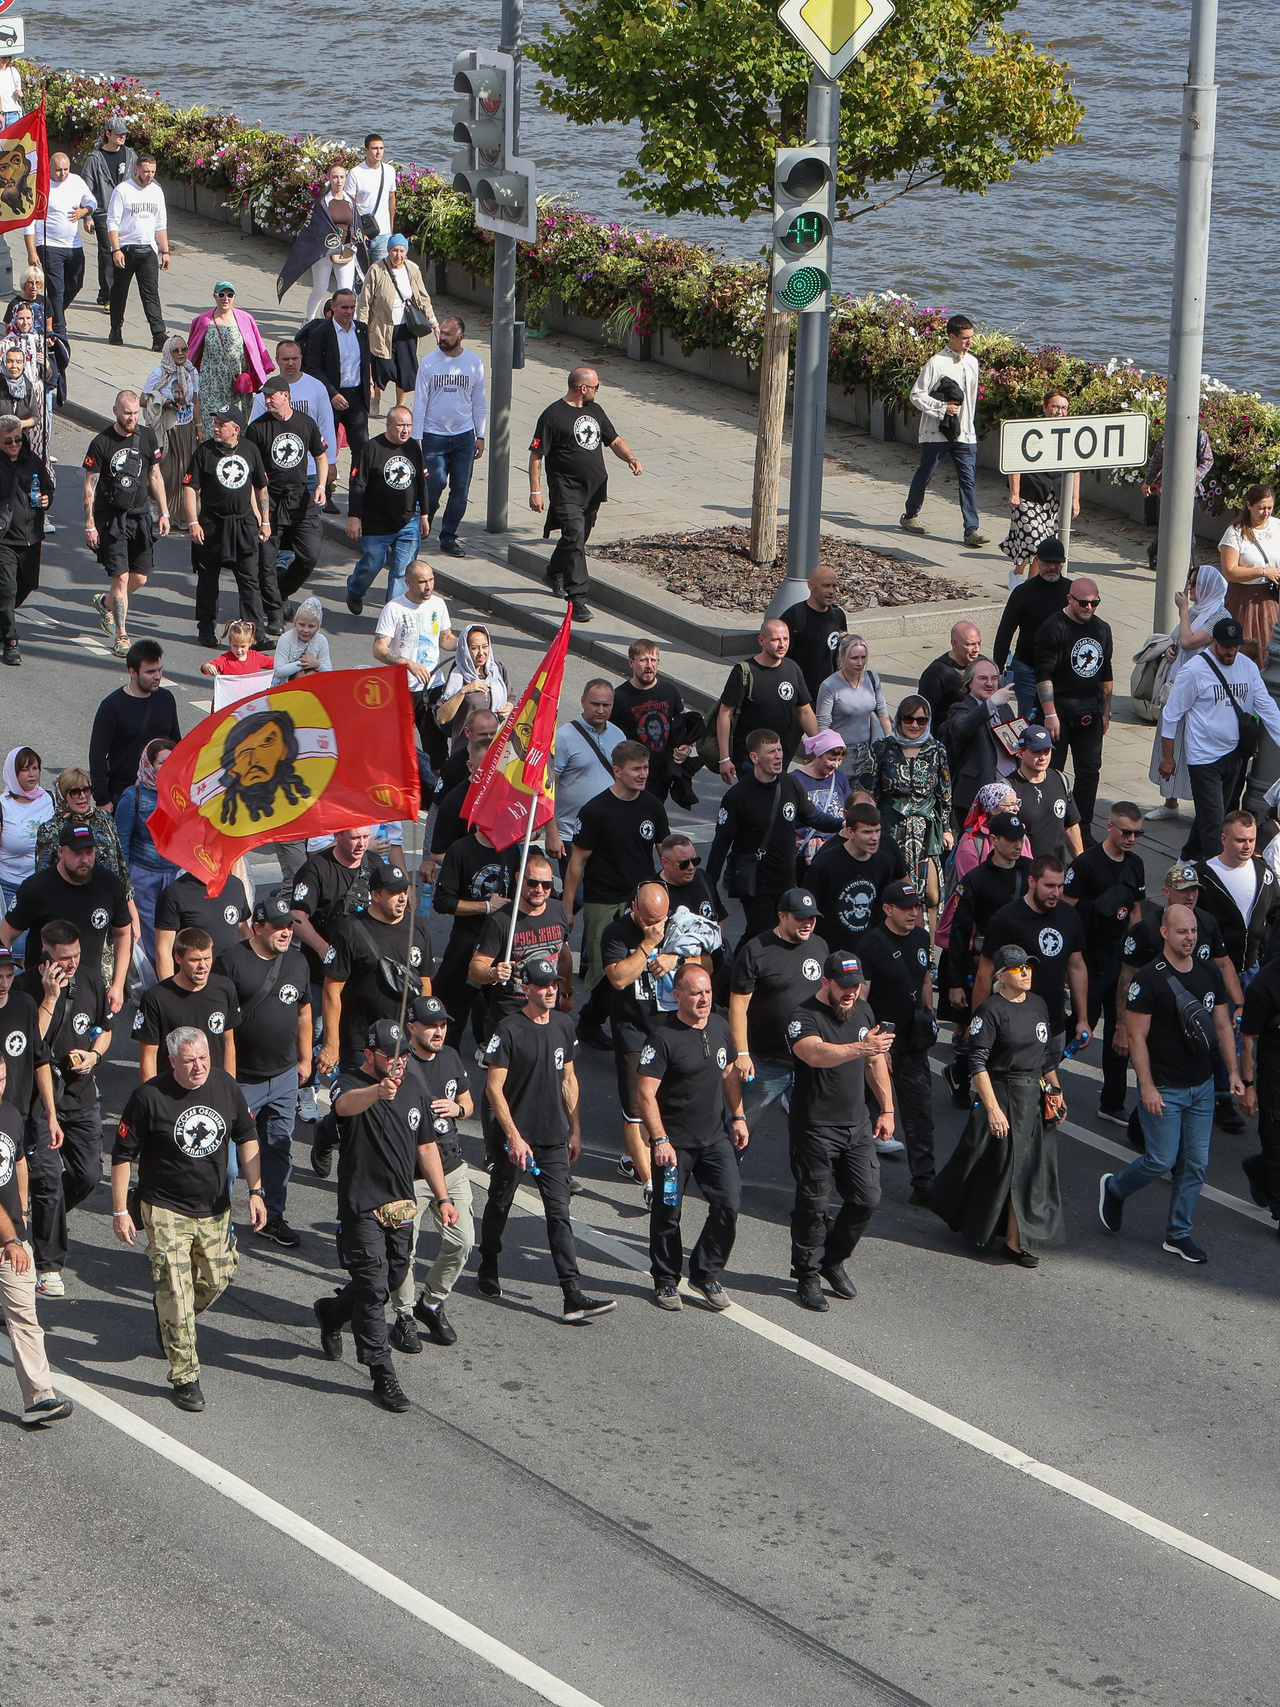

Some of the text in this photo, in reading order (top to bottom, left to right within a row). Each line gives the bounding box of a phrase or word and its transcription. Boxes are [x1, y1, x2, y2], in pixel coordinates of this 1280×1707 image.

[1021, 424, 1125, 463] СТОП
[514, 929, 537, 946] РУСЬ
[538, 925, 562, 942] ЖИВА
[176, 1107, 224, 1136] РУССКАЯ ОБЩИНА
